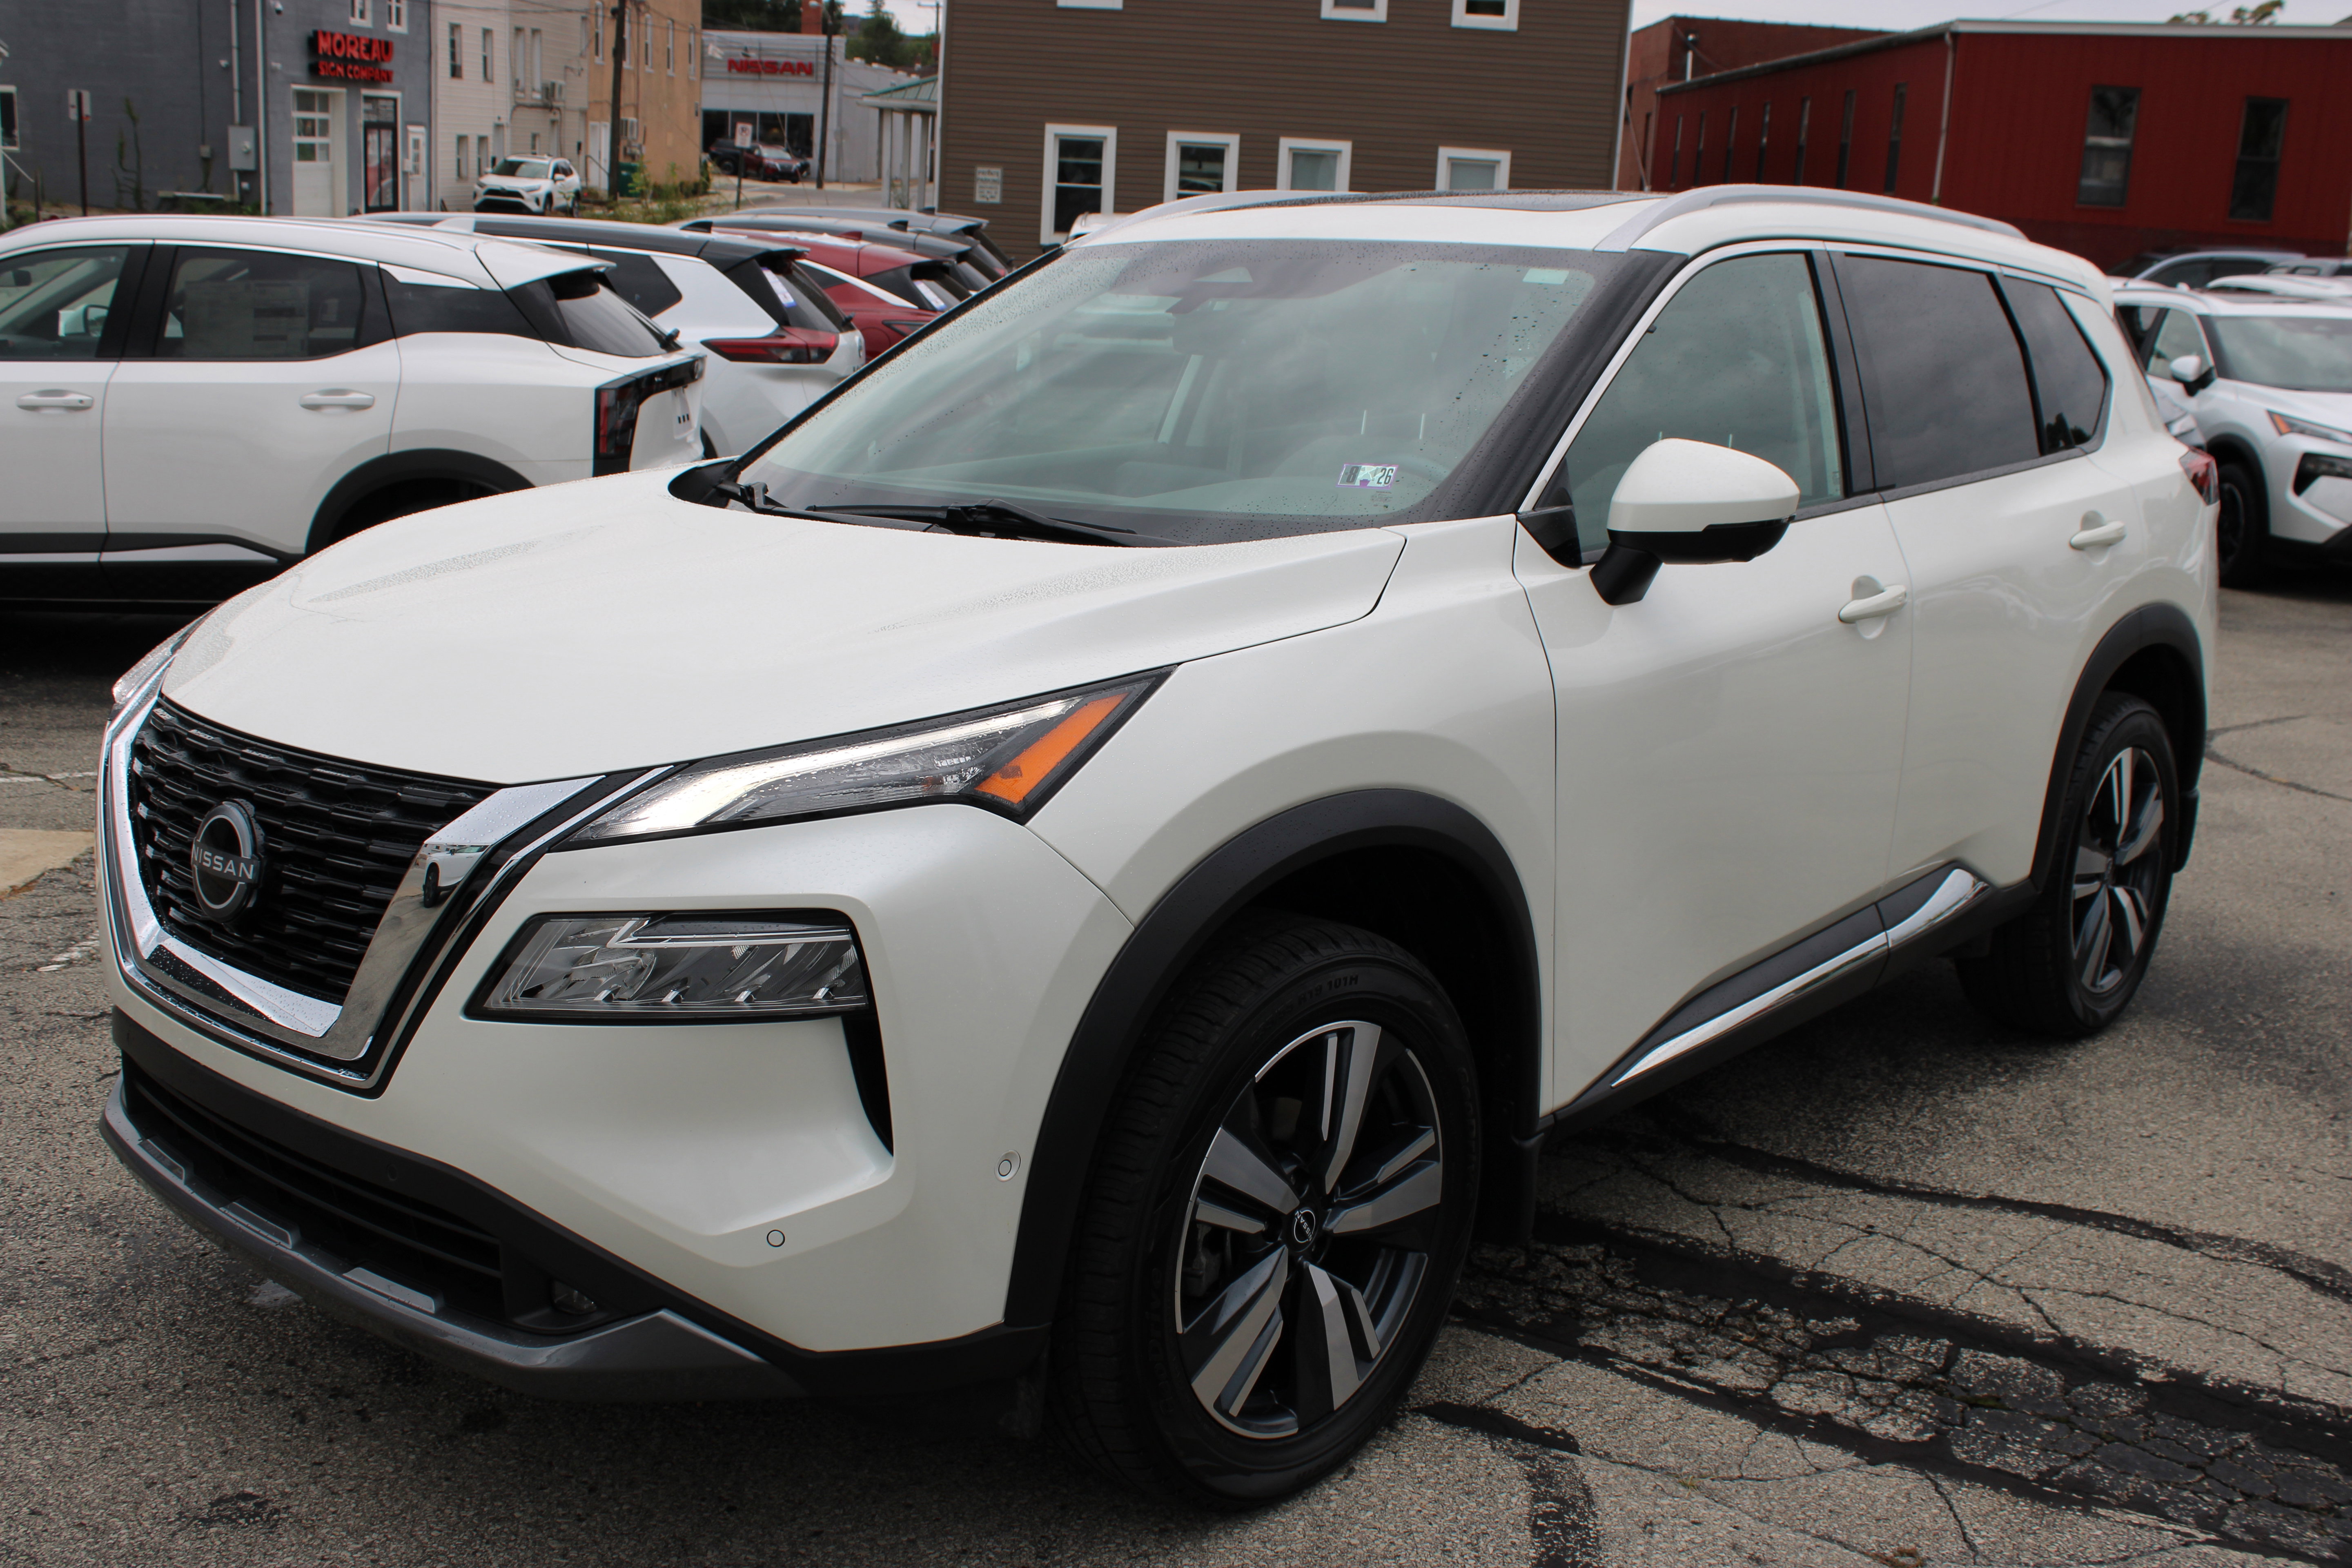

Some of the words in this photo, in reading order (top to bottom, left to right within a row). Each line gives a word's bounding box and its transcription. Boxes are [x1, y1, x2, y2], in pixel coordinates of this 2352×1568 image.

[317, 30, 393, 62] MOREAU
[318, 61, 344, 76] SIGN
[347, 65, 393, 82] COMPANY
[727, 58, 813, 76] NISSAN
[1346, 466, 1359, 483] 8
[1376, 468, 1394, 485] 26
[192, 844, 254, 879] NISSAN
[1327, 974, 1359, 991] 101H
[1295, 1211, 1312, 1241] NISSAN
